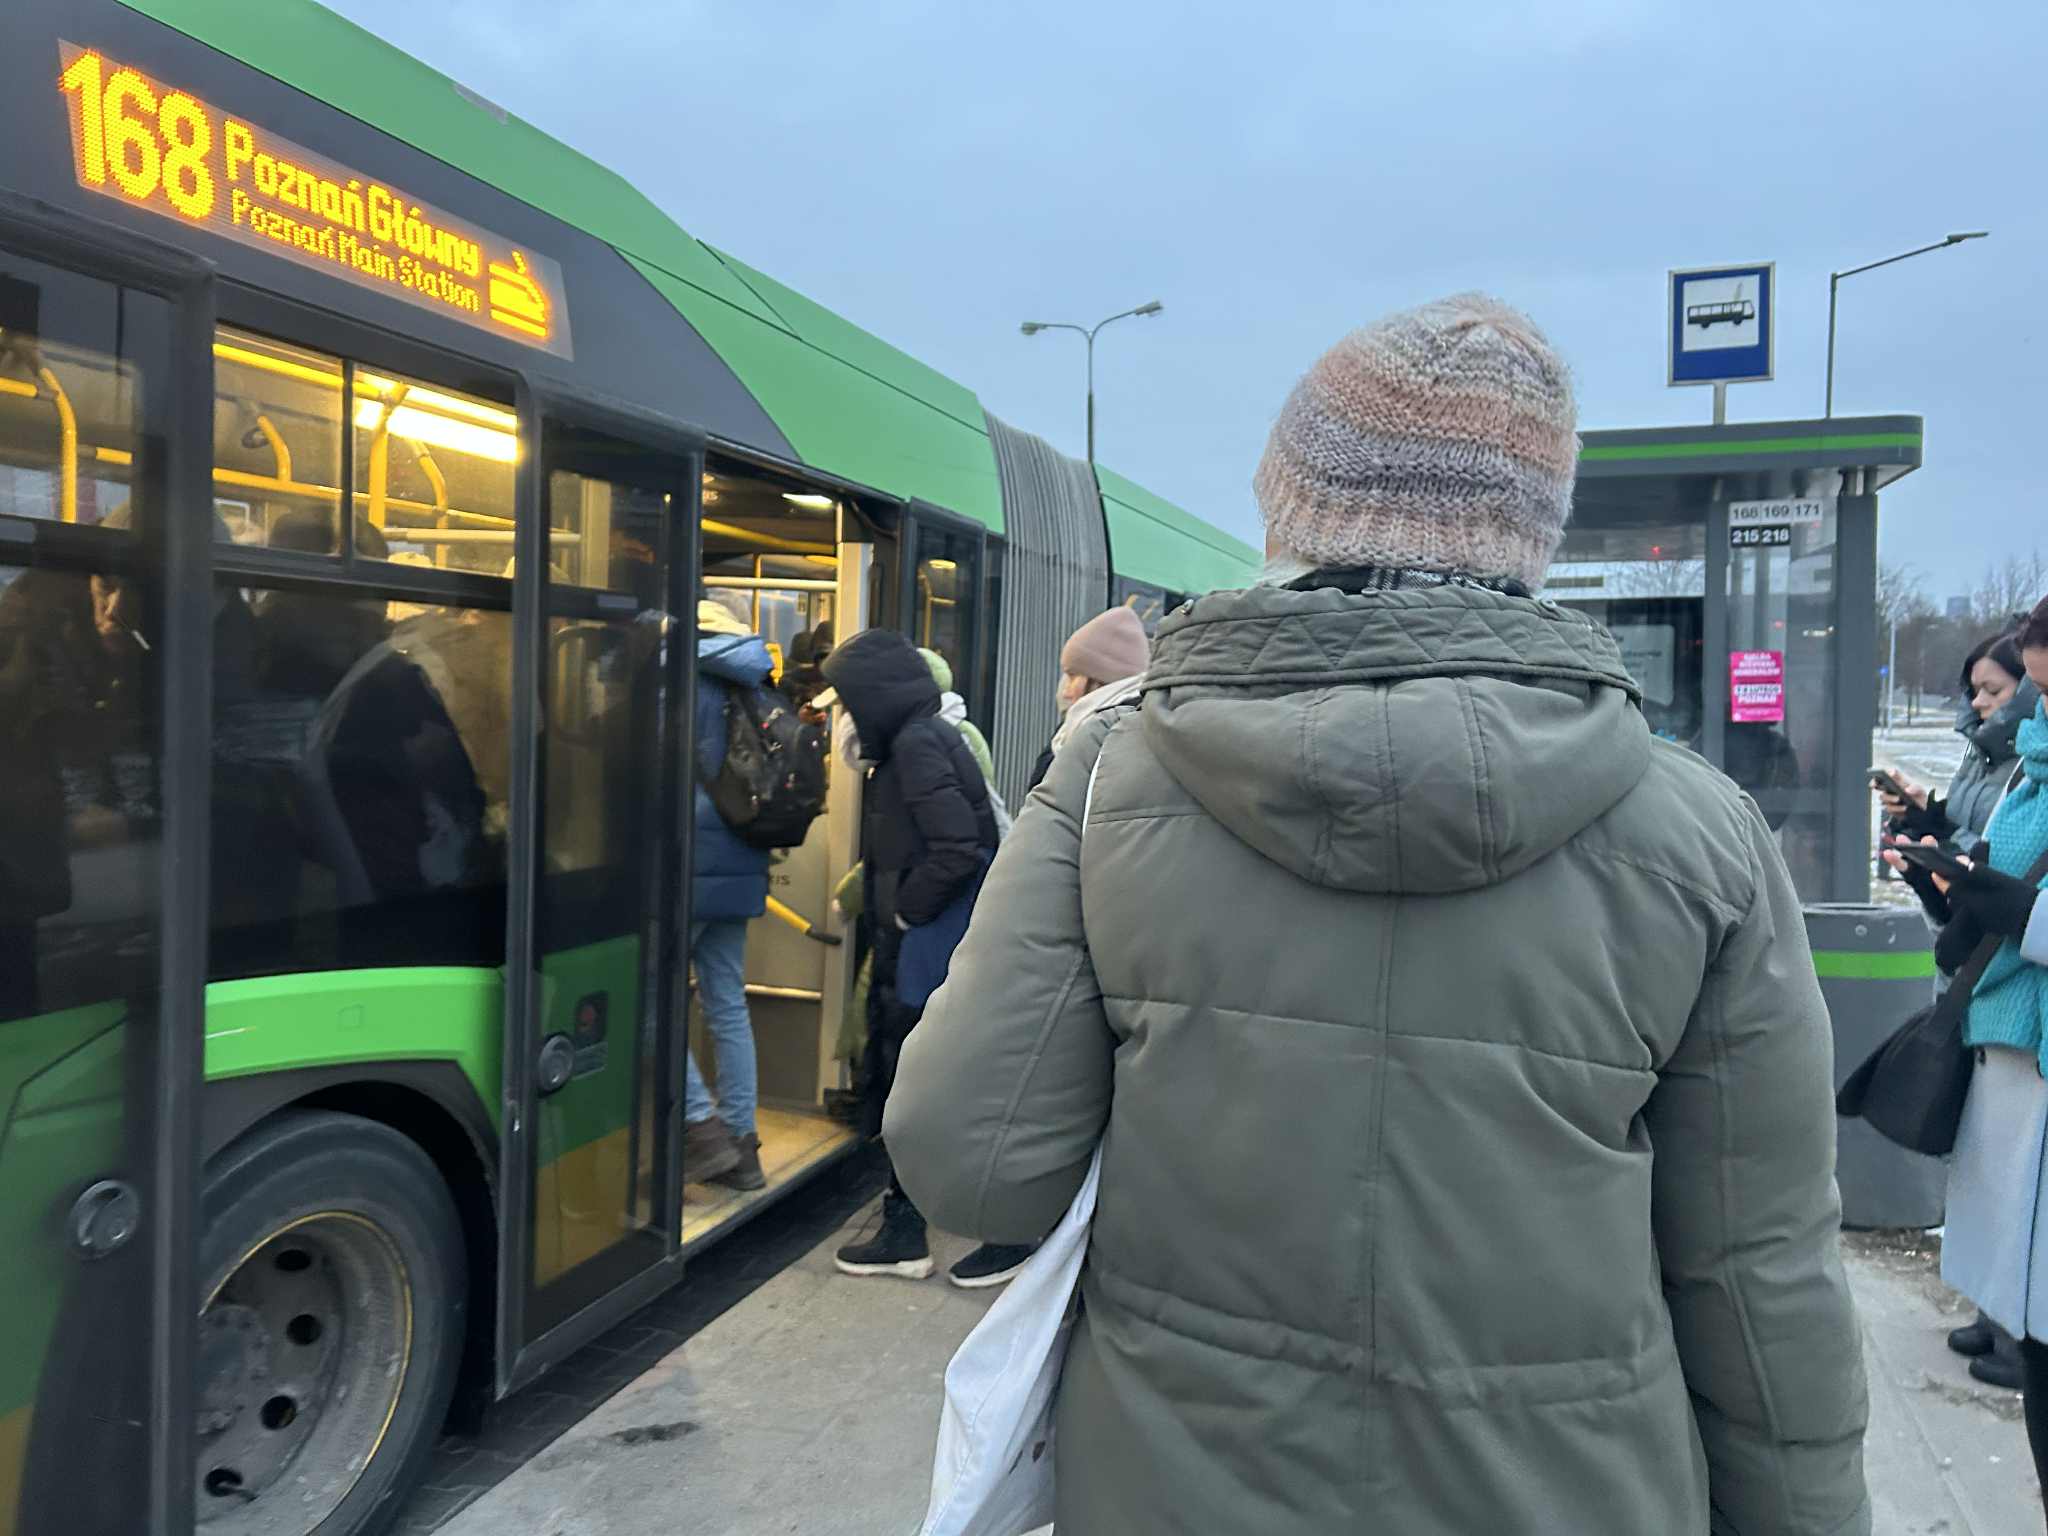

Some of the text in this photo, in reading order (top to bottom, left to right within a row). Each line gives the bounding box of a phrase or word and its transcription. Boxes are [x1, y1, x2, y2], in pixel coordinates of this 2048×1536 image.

[60, 50, 214, 219] 168
[223, 117, 481, 277] Poznań Główny
[232, 187, 481, 313] Poznań Main Station
[1732, 528, 1789, 544] 215 218
[1733, 503, 1820, 519] 168 169 171
